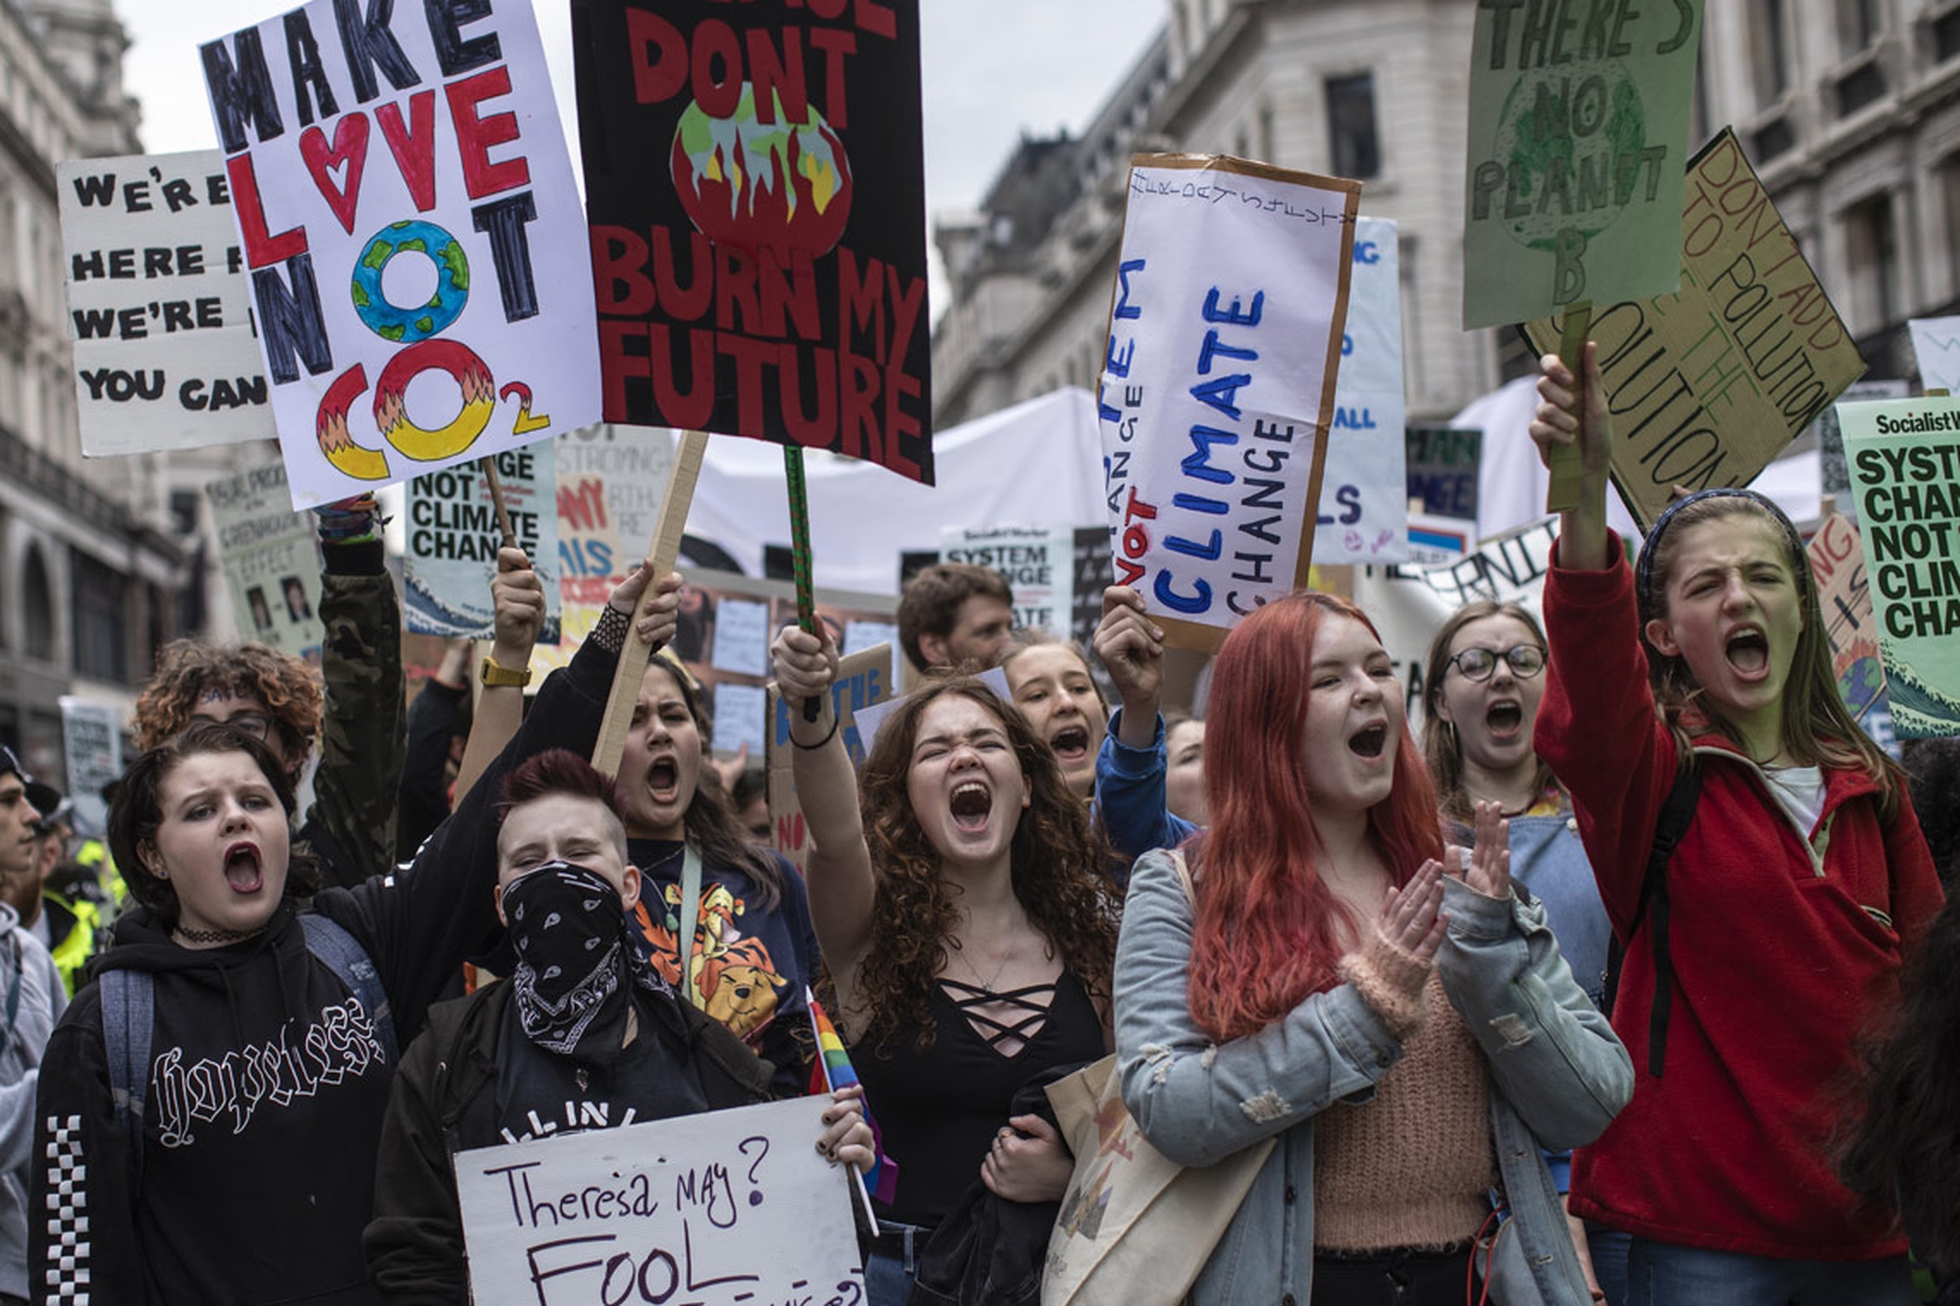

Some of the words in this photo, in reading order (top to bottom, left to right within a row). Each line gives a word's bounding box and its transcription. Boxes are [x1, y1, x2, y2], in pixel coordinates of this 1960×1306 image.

[200, 0, 502, 154] MAKE
[626, 7, 857, 131] DONT
[1533, 75, 1607, 143] NO
[73, 165, 230, 214] WE'RE
[1472, 145, 1668, 221] PLANET
[1682, 180, 1724, 259] TO
[72, 244, 205, 281] HERE
[1552, 227, 1590, 305] B
[1699, 139, 1801, 278] DON'T
[1777, 282, 1843, 351] ADD
[73, 297, 223, 340] WE'RE
[252, 190, 538, 387] NOT
[588, 223, 822, 341] BURN
[837, 246, 927, 368] MY
[79, 368, 165, 402] YOU
[599, 320, 923, 482] FUTURE
[1552, 300, 1740, 496] OLUTION
[1680, 310, 1761, 427] THE
[1152, 284, 1266, 615] CLIMATE
[1877, 410, 1952, 435] Socialist
[412, 472, 475, 501] NOT
[412, 500, 540, 540] CLIMATE
[1225, 417, 1295, 618] CHANGE
[412, 530, 536, 562] CHANE
[947, 545, 1048, 566] SYSTEM
[1000, 565, 1053, 586] NGE
[1870, 522, 1952, 562] NOT
[526, 1217, 760, 1306] FOOL
